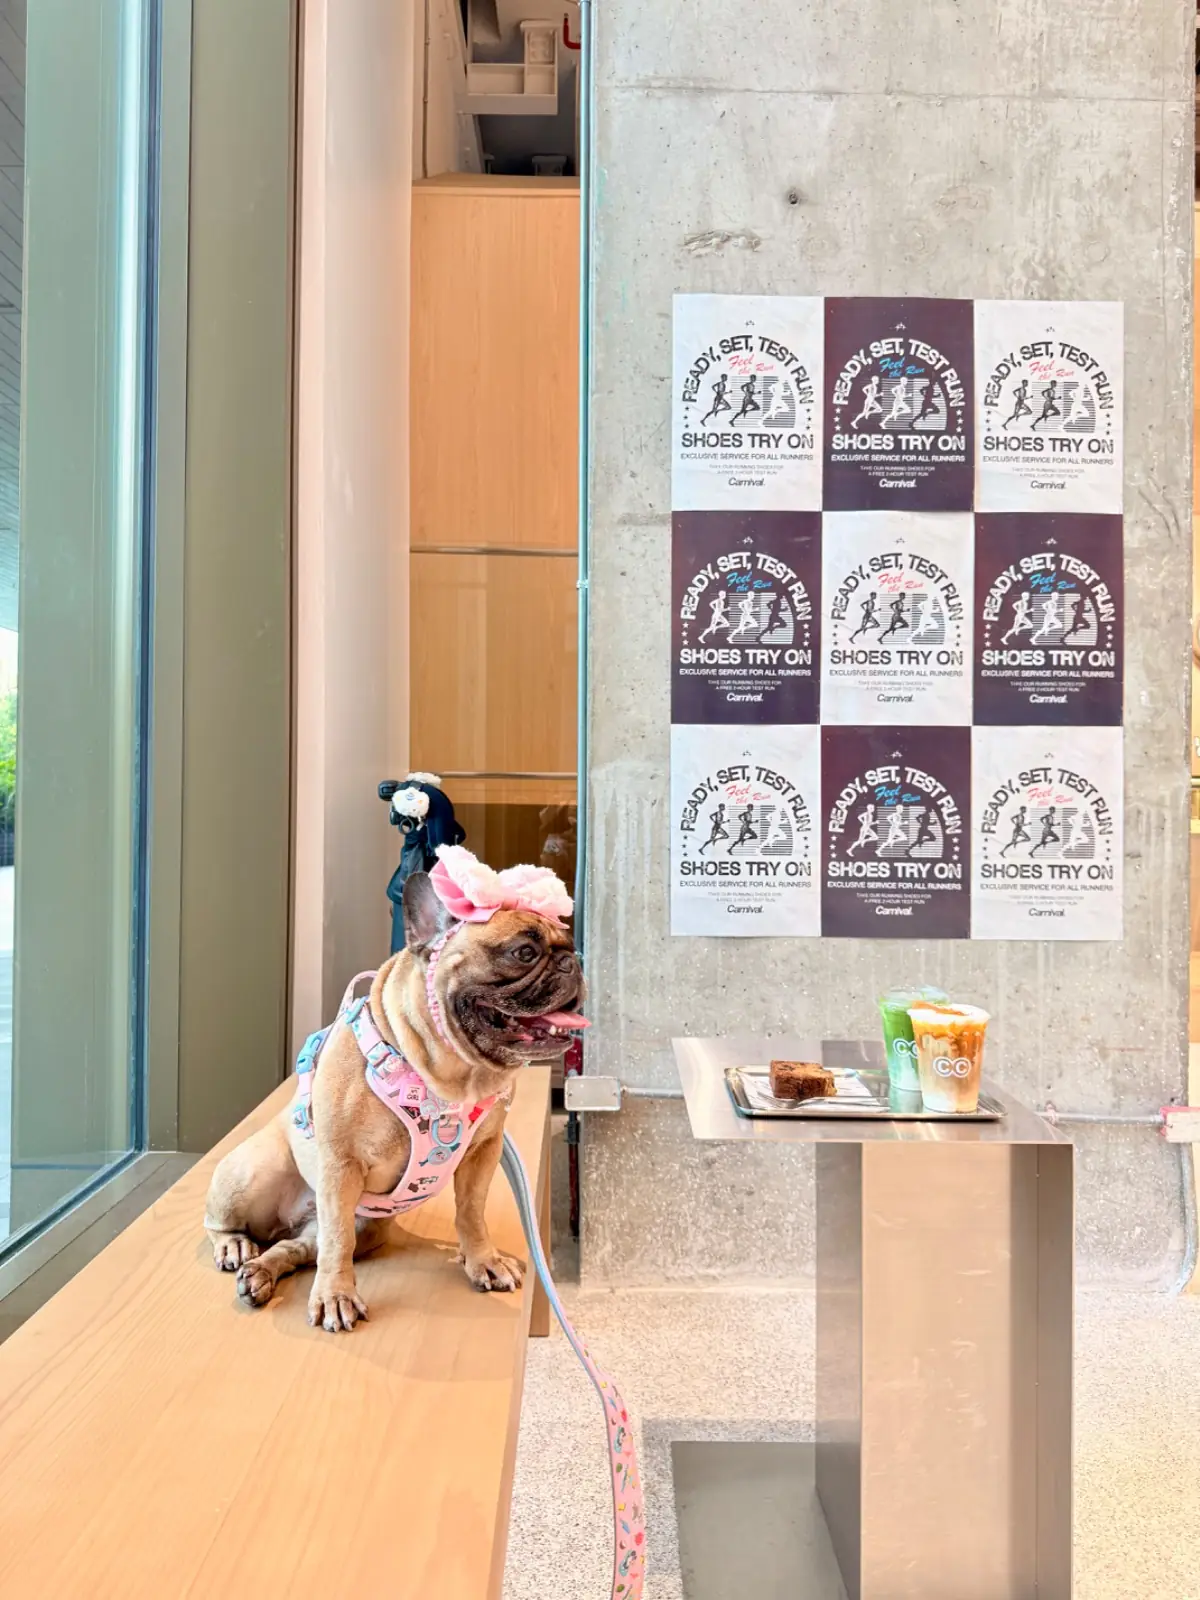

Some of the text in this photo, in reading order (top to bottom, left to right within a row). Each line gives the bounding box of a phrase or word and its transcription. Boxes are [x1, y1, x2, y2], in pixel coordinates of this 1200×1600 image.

[682, 334, 815, 405] READY, SET, TEST RUN
[728, 353, 754, 369] Feel
[879, 356, 905, 372] Feel
[1029, 358, 1055, 375] Feel
[833, 338, 965, 408] READY, SET, TEST RUN
[984, 340, 1115, 410] READY, SET, TEST RUN
[681, 433, 814, 449] SHOES TRY ON
[832, 434, 965, 451] SHOES TRY ON
[983, 437, 1115, 454] SHOES TRY ON
[681, 552, 812, 621] READY, SET, TEST RUN
[726, 570, 752, 586] Feel
[878, 570, 904, 587] Feel
[1030, 571, 1055, 588] Feel
[831, 552, 964, 622] READY, SET, TEST RUN
[983, 553, 1116, 623] READY, SET, TEST RUN
[680, 649, 812, 665] SHOES TRY ON
[830, 650, 964, 666] SHOES TRY ON
[982, 650, 1116, 666] SHOES TRY ON
[680, 765, 812, 833] READY, SET, TEST RUN
[726, 782, 751, 799] Feel
[875, 783, 901, 800] Feel
[1027, 785, 1053, 801] Feel
[829, 765, 962, 835] READY, SET, TEST RUN
[981, 767, 1114, 836] READY, SET, TEST RUN
[680, 860, 812, 877] SHOES TRY ON
[828, 862, 962, 878] SHOES TRY ON
[980, 864, 1115, 880] SHOES TRY ON
